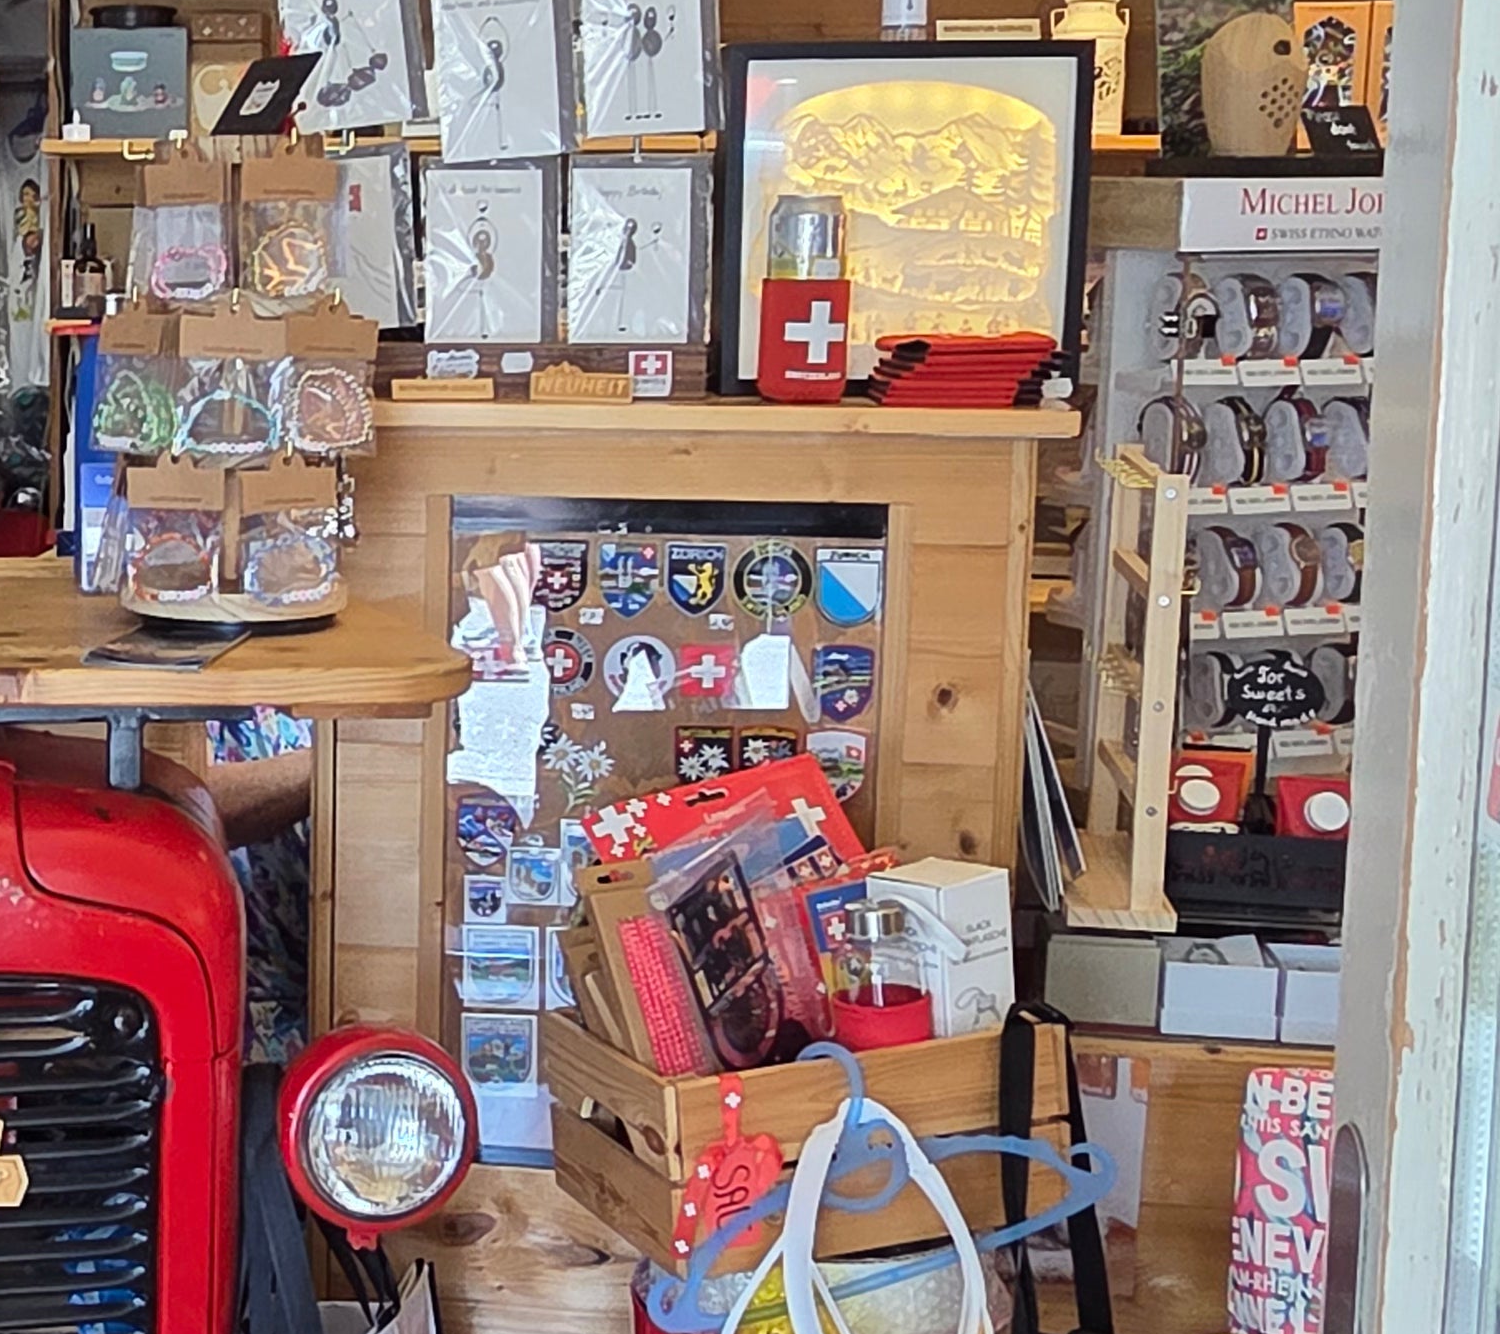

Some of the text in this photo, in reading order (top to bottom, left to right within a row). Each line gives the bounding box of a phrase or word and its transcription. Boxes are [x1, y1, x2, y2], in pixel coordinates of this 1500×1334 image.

[1240, 187, 1339, 216] MICHEL
[536, 376, 628, 396] NEUHEIT
[712, 1164, 753, 1232] SAL
